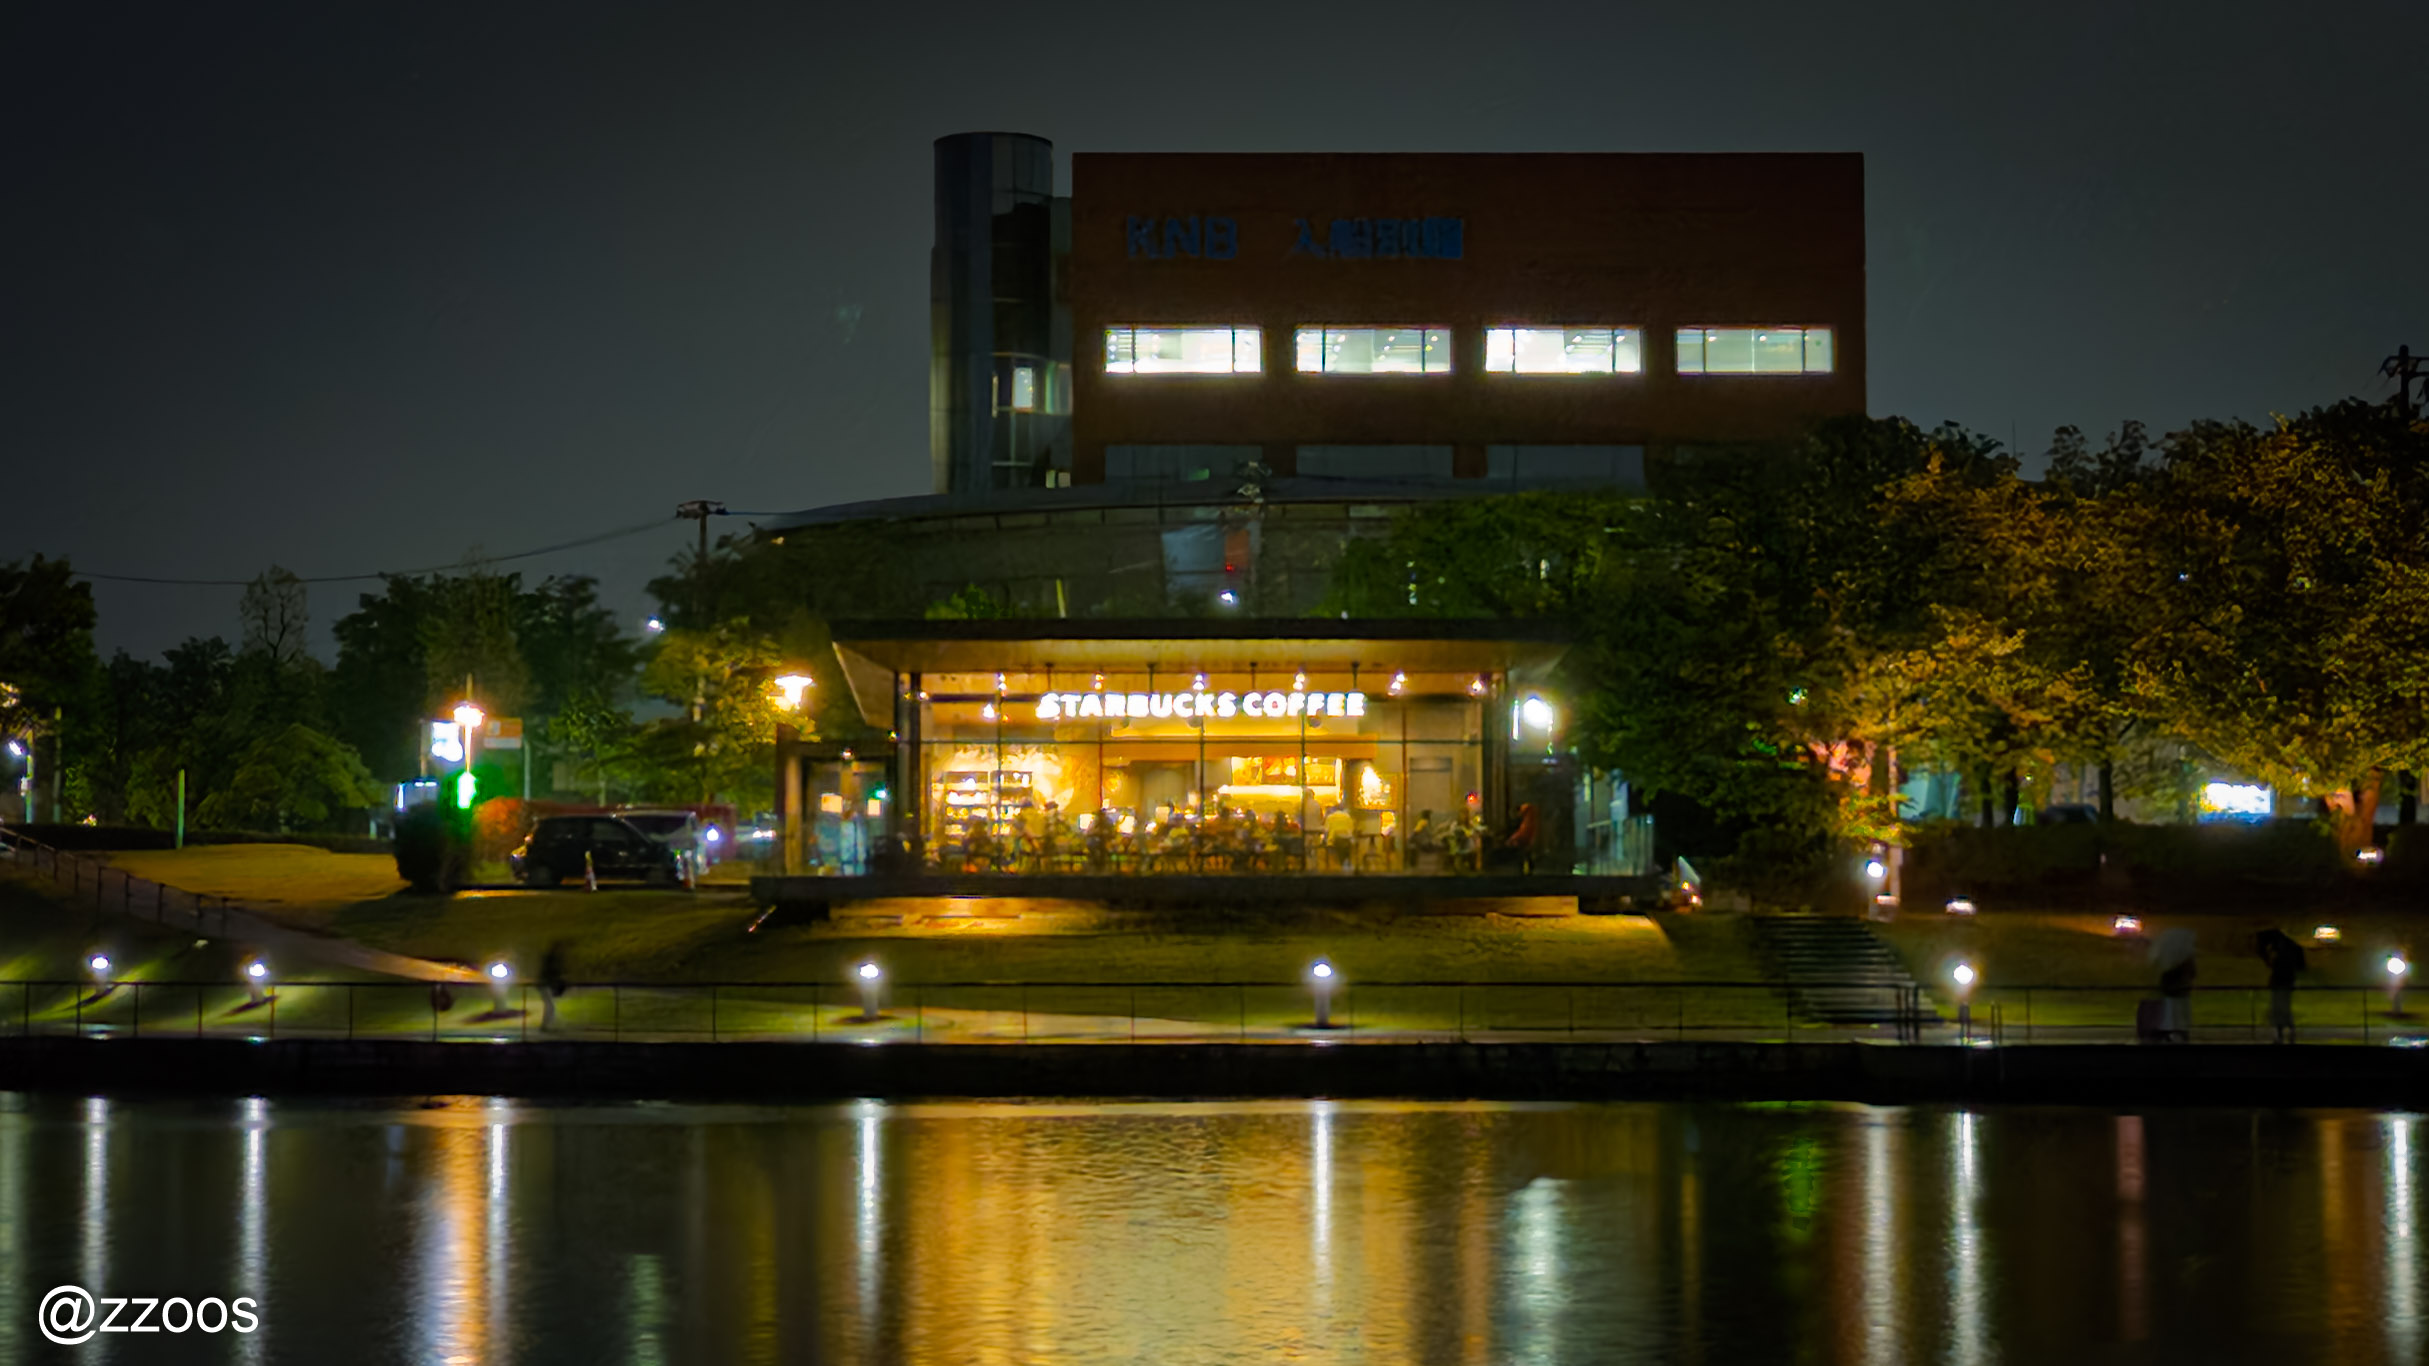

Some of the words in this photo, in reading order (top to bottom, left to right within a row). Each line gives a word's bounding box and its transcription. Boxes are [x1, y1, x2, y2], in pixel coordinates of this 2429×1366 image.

[1127, 215, 1238, 259] KNB
[1036, 692, 1237, 719] STARBUCKS
[1243, 692, 1366, 718] COFFEE
